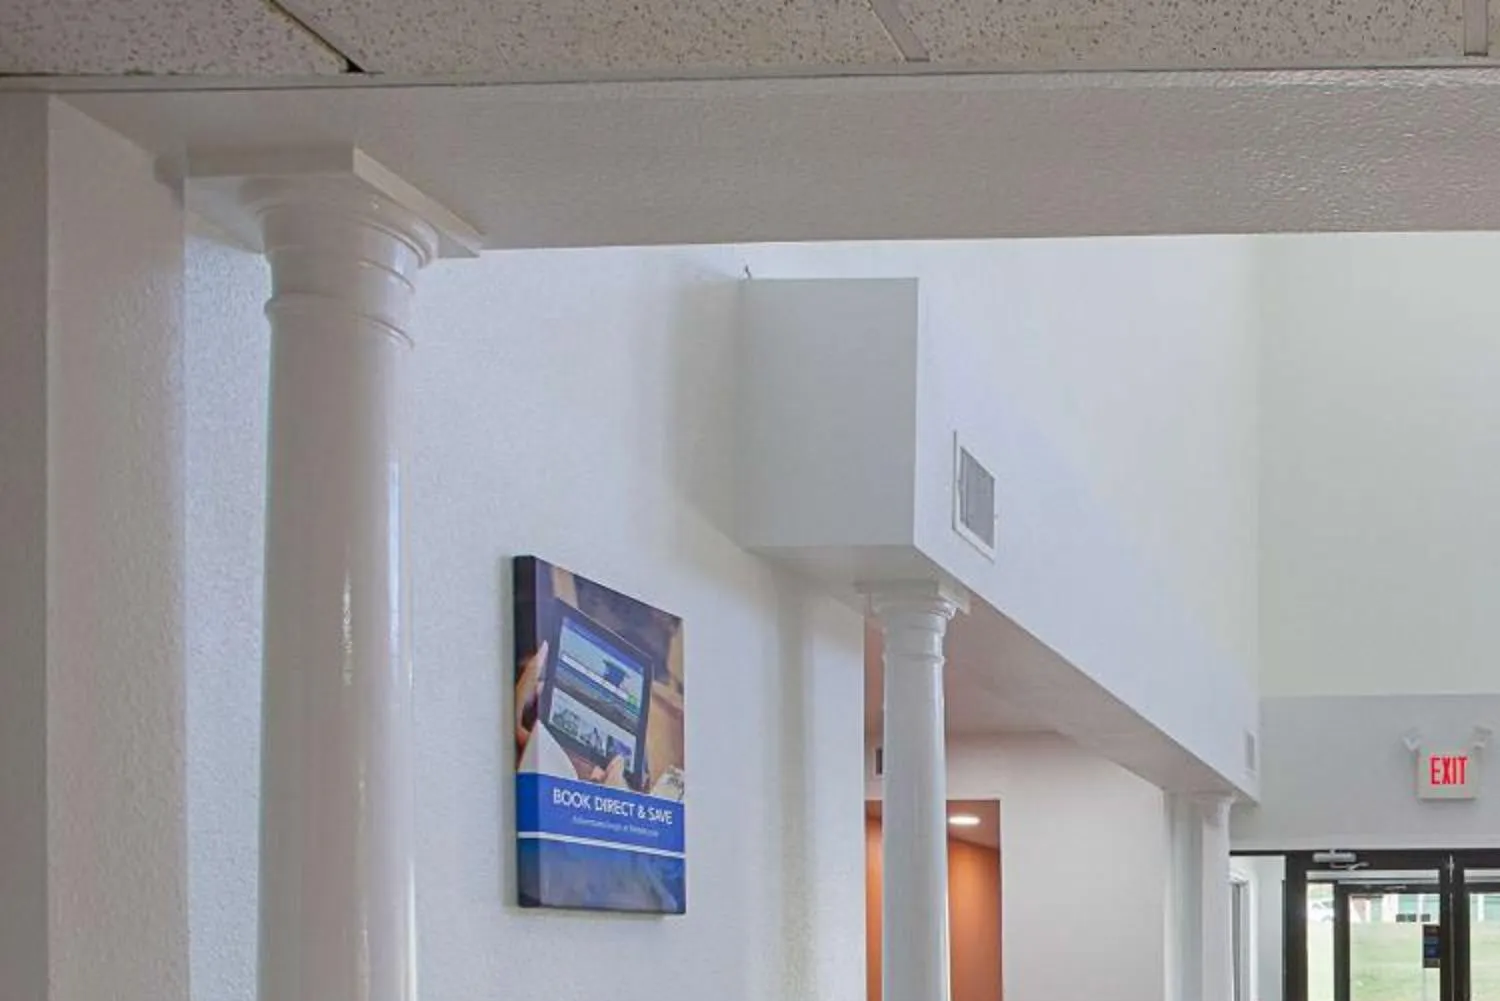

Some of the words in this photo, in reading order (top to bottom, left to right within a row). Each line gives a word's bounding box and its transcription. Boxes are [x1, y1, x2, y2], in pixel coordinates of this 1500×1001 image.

[1430, 755, 1467, 785] EXIT
[553, 787, 591, 810] BOOK
[595, 796, 635, 816] DIRECT
[637, 804, 646, 819] &
[647, 807, 673, 825] SAVE
